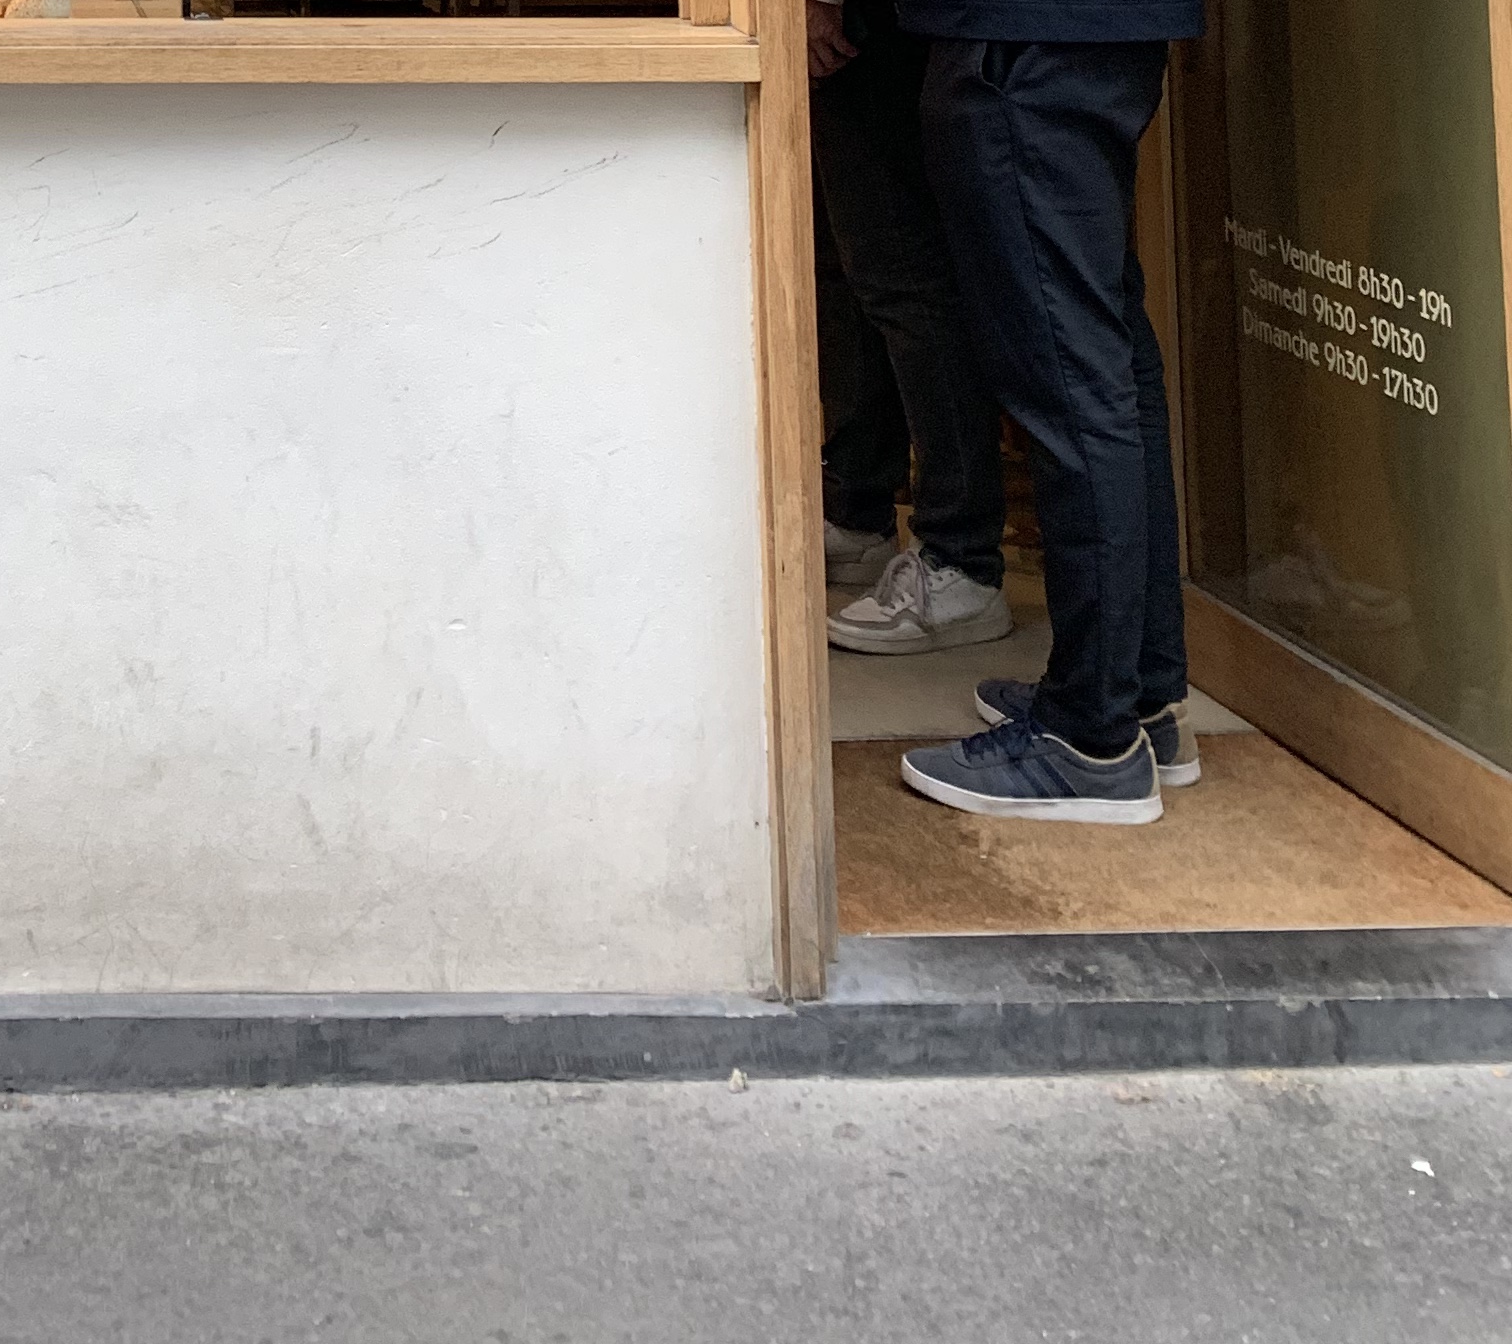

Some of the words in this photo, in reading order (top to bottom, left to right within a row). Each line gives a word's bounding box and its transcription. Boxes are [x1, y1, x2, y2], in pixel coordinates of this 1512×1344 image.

[1224, 216, 1268, 257] Mardi
[1278, 235, 1352, 289] Vendredi
[1249, 268, 1307, 316] Samedi
[1242, 305, 1320, 366] Dimanche
